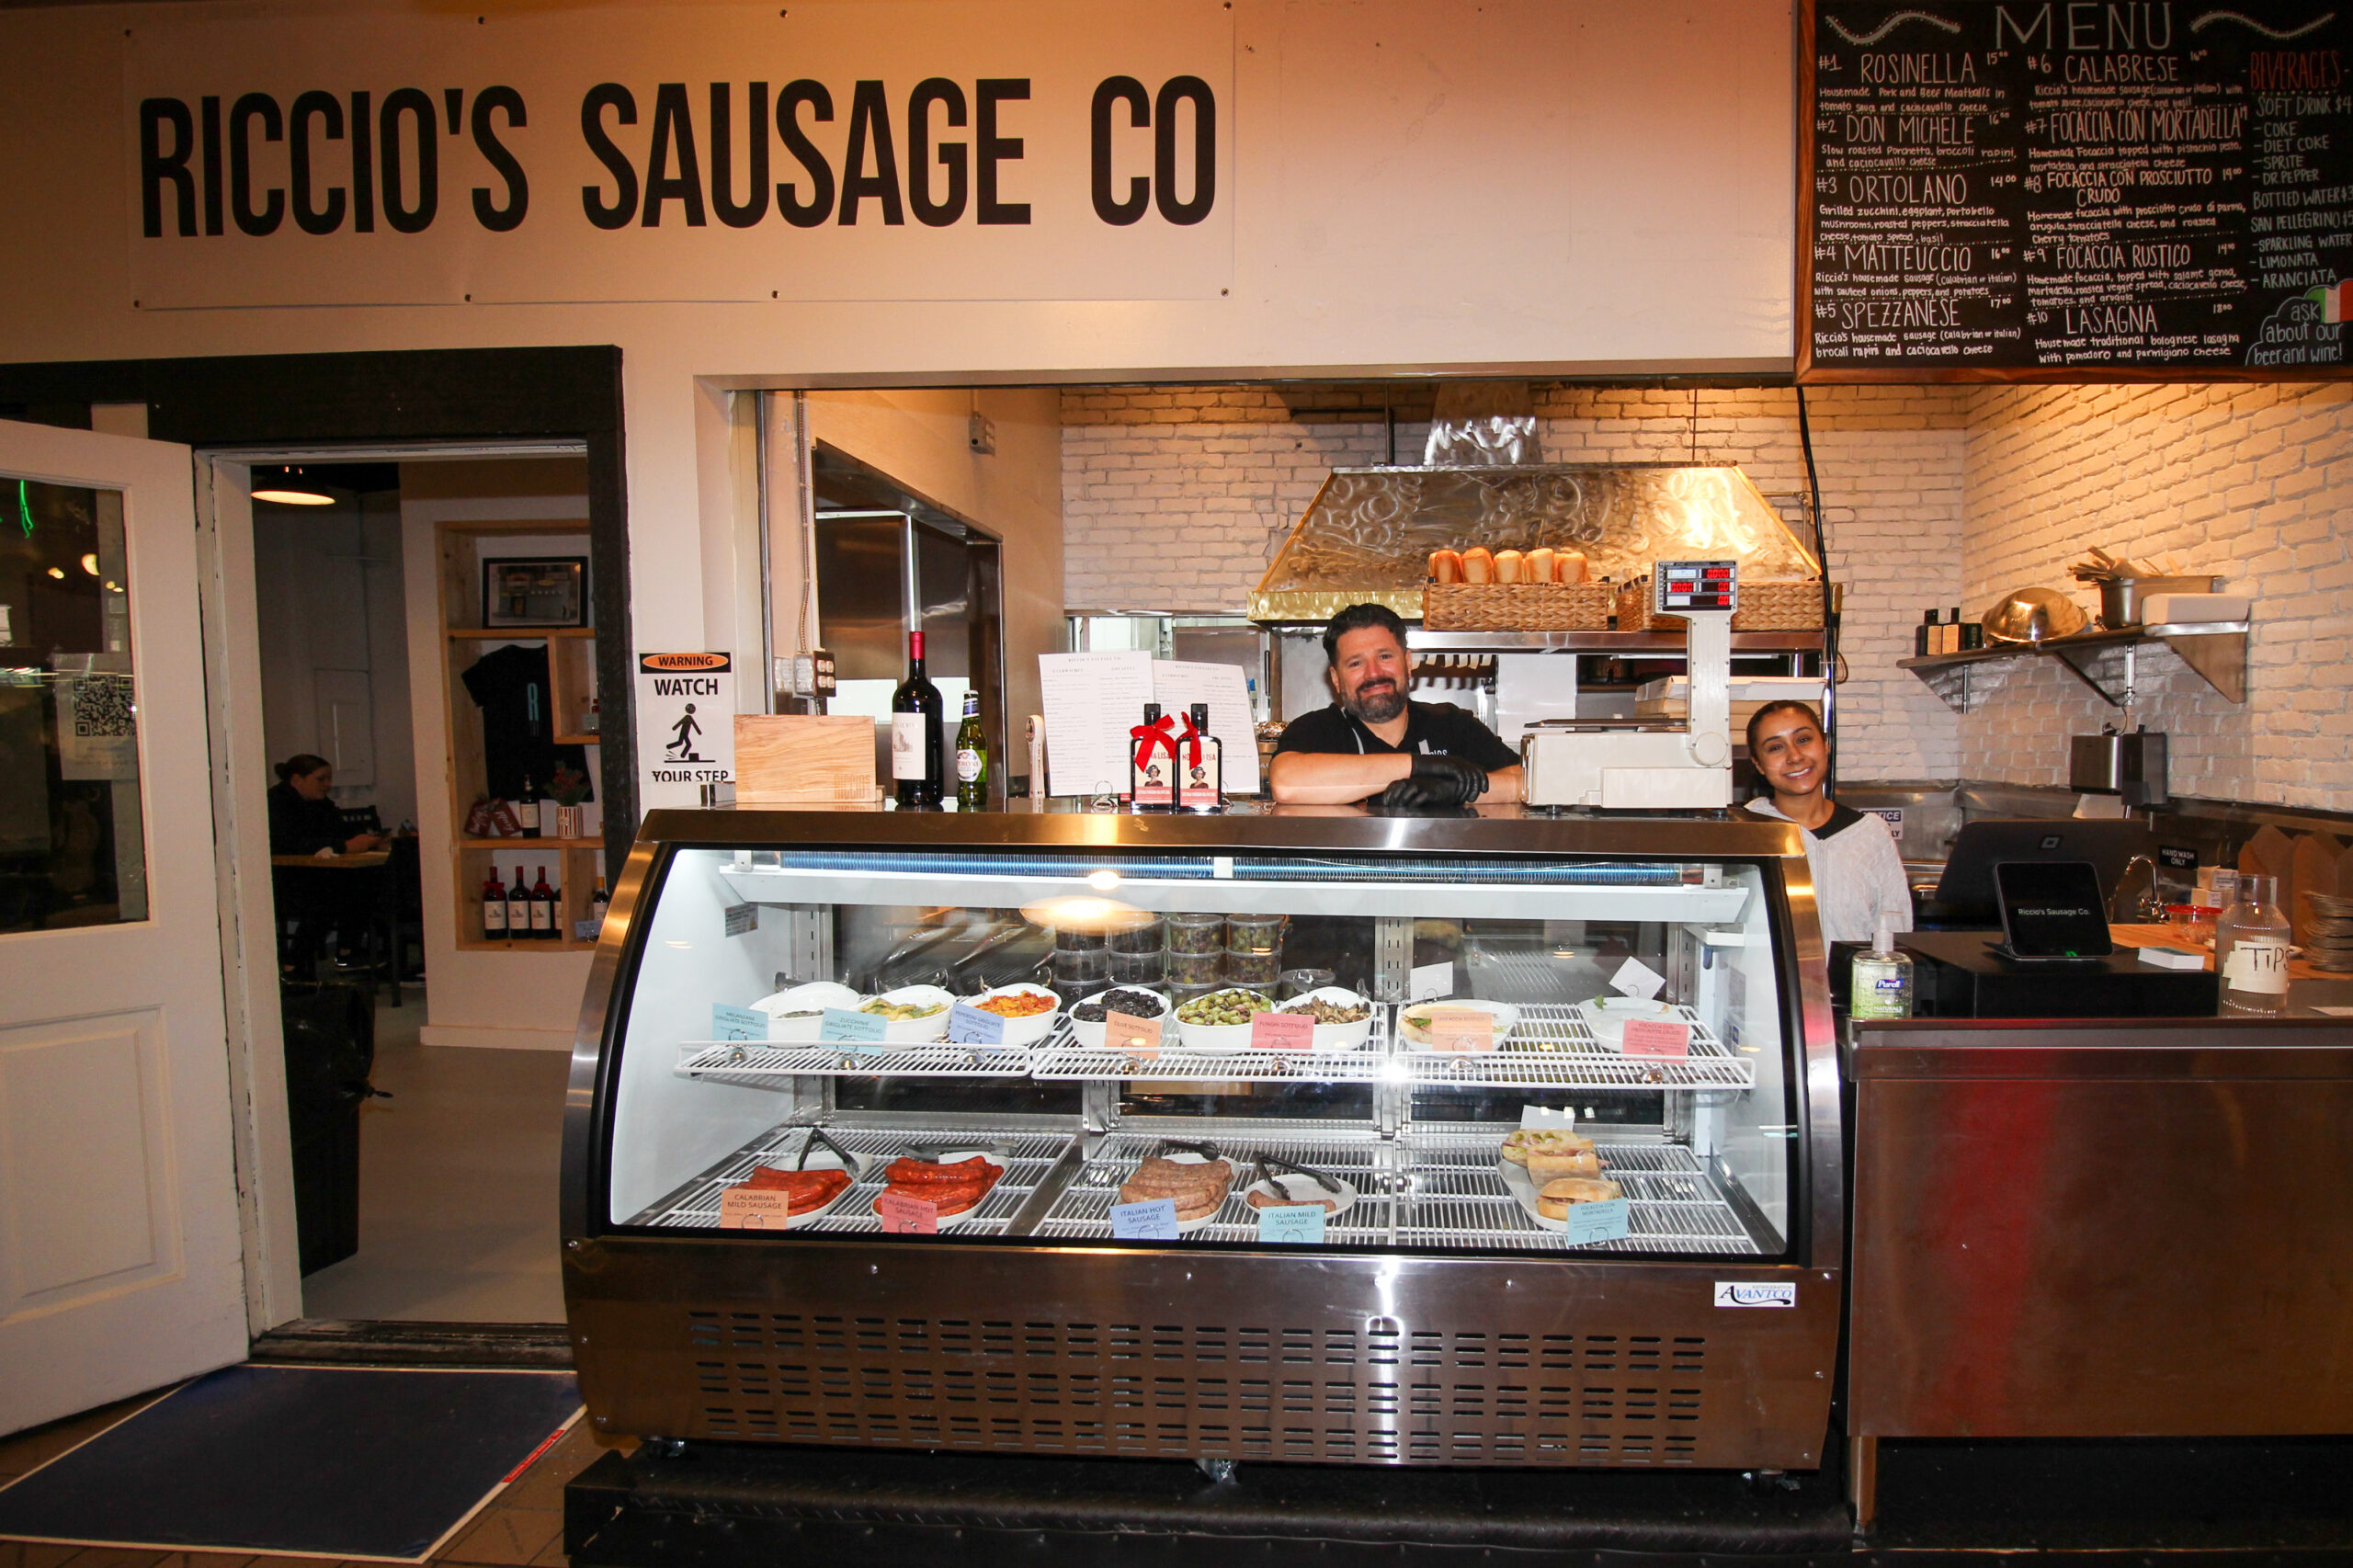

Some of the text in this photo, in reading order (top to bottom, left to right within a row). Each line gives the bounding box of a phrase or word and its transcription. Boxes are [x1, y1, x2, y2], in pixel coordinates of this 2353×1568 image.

[1995, 2, 2172, 51] MENU
[1819, 52, 1975, 84] #1 ROSINELLA
[2065, 54, 2178, 83] CALABRESE
[2251, 51, 2340, 90] BEVERAGES
[1820, 88, 1870, 97] Housemade
[1900, 88, 1915, 97] and
[1920, 88, 1939, 97] Beef
[1945, 87, 1990, 98] Meatballs
[1995, 89, 2005, 98] in
[2035, 85, 2067, 96] Riccio's
[1819, 102, 1851, 111] tomato
[1881, 103, 1894, 111] and
[2256, 95, 2351, 117] SOFT DRINK $4
[1816, 115, 1973, 144] #2 DON MICHELE
[2025, 107, 2241, 143] #7 FOCACCIA CON MORTADELLA
[2264, 121, 2298, 137] COKE
[1822, 144, 1974, 156] Slow roasted broccoli
[2264, 135, 2329, 153] DIET COKE
[140, 74, 1216, 238] RICCIO'S SAUSAGE CO
[2029, 145, 2173, 162] Homemade Focaccia topped with
[2263, 154, 2304, 169] SPRITE
[1826, 158, 1845, 167] and
[2079, 162, 2094, 171] and
[2024, 168, 2211, 193] #8 FOCACCIA CON PROSCIUTTO
[2281, 169, 2319, 183] PEPPER
[1816, 175, 1966, 203] #3 ORTOLANO
[2077, 188, 2120, 207] CRUDO
[2254, 191, 2299, 210] BOTTLED
[2303, 187, 2339, 206] WATER
[1820, 204, 1994, 217] Grilled portobello
[2028, 201, 2215, 222] Homemade focaccia with di
[2160, 218, 2175, 227] and
[2251, 217, 2272, 233] SAN
[2277, 211, 2340, 229] PELLEGRINO
[1921, 233, 1943, 244] basil
[2067, 233, 2109, 242] tomatoes
[2258, 233, 2352, 253] SPARKLING WATER
[1814, 244, 1970, 271] #4 MATTEUCCIO
[2023, 244, 2189, 268] #9 FOCACCIA RUSTICO
[2259, 253, 2319, 268] LIMONATA
[1815, 272, 1934, 284] Riccio's housemade sausage
[2027, 275, 2073, 285] Homemade
[2118, 271, 2144, 281] topped
[2149, 270, 2169, 279] with
[2263, 268, 2336, 289] ARANCIATA
[1814, 288, 1833, 296] with
[2107, 282, 2132, 294] veggie
[2079, 295, 2095, 303] and
[1815, 299, 1961, 329] #5 SPEZZANESE
[2027, 305, 2158, 335] #10 LASAGNA
[2291, 303, 2320, 322] ask
[1815, 333, 1847, 344] Riccio's
[1852, 333, 1897, 343] housemade
[1904, 331, 1937, 342] sausage
[2090, 335, 2143, 347] traditional
[2150, 335, 2198, 347] bolognese
[2204, 334, 2240, 346] lasagna
[2267, 324, 2344, 343] about our
[1853, 344, 1993, 358] rapini and cheese
[2039, 347, 2232, 364] with pomodoro and parmigiano cheese
[2254, 343, 2343, 366] beer and wine!
[658, 656, 713, 666] WARNING
[654, 678, 719, 696] WATCH
[527, 682, 540, 722] R
[652, 770, 729, 782] YOUR STEP
[2162, 848, 2195, 859] HAND WASH
[2170, 857, 2186, 866] ONLY
[2046, 908, 2076, 916] Sausage
[2240, 947, 2290, 973] TIPS
[734, 1194, 776, 1202] CALABRIAN
[748, 1201, 781, 1210] SAUSAGE
[884, 1198, 934, 1214] CALABRIAN HOT
[894, 1206, 923, 1218] SAUSAGE
[1120, 1208, 1148, 1217] ITALIAN
[1128, 1214, 1161, 1223] SAUSAGE
[1719, 1285, 1792, 1305] AVANTCO
